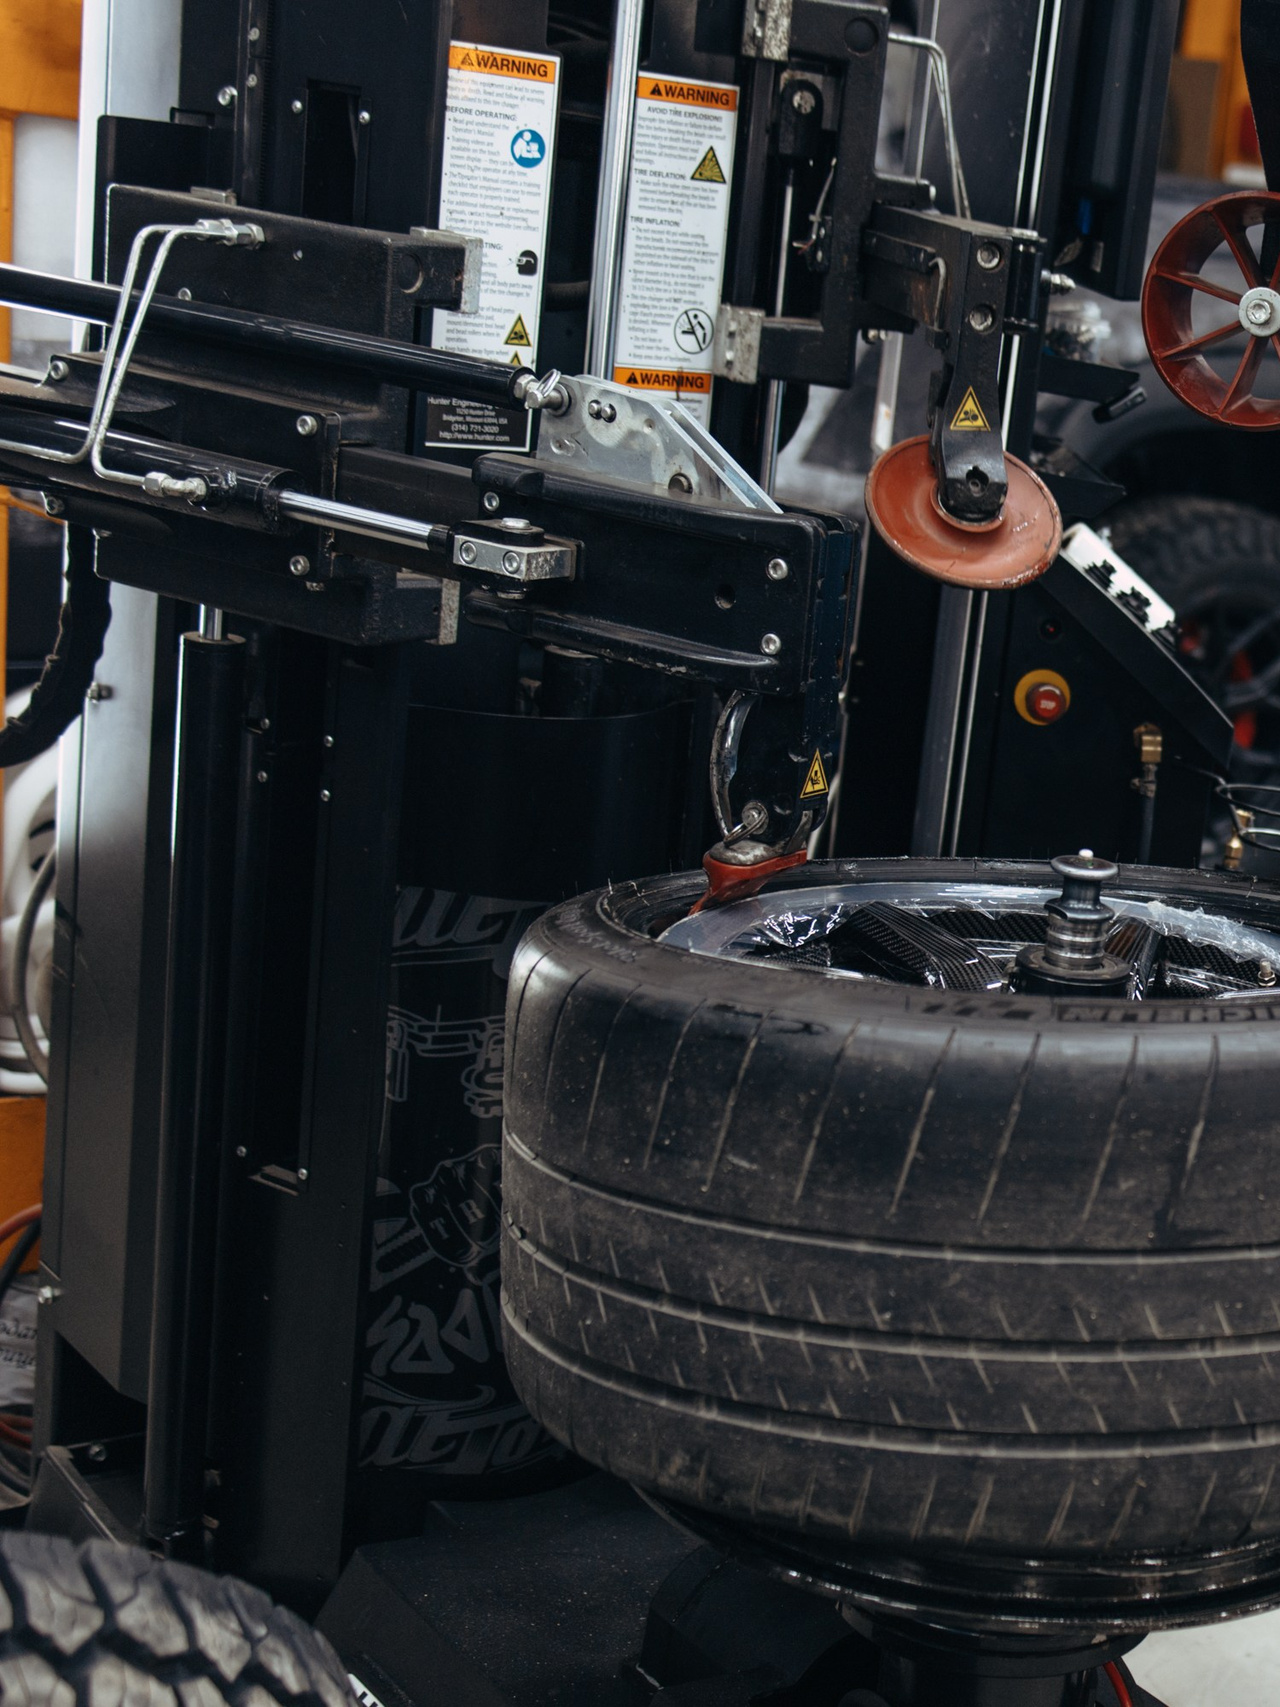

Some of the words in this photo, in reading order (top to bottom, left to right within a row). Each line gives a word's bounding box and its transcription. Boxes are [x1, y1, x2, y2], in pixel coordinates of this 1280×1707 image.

[476, 53, 548, 77] WARNING
[664, 84, 730, 106] WARNING
[446, 106, 473, 115] BEFORE
[475, 110, 517, 121] OPERATING:
[647, 106, 668, 115] AVOID
[670, 109, 682, 118] TIRE
[634, 168, 648, 176] TIRE
[630, 216, 644, 224] TIRE
[484, 242, 503, 250] TING:
[640, 372, 704, 389] WARNING
